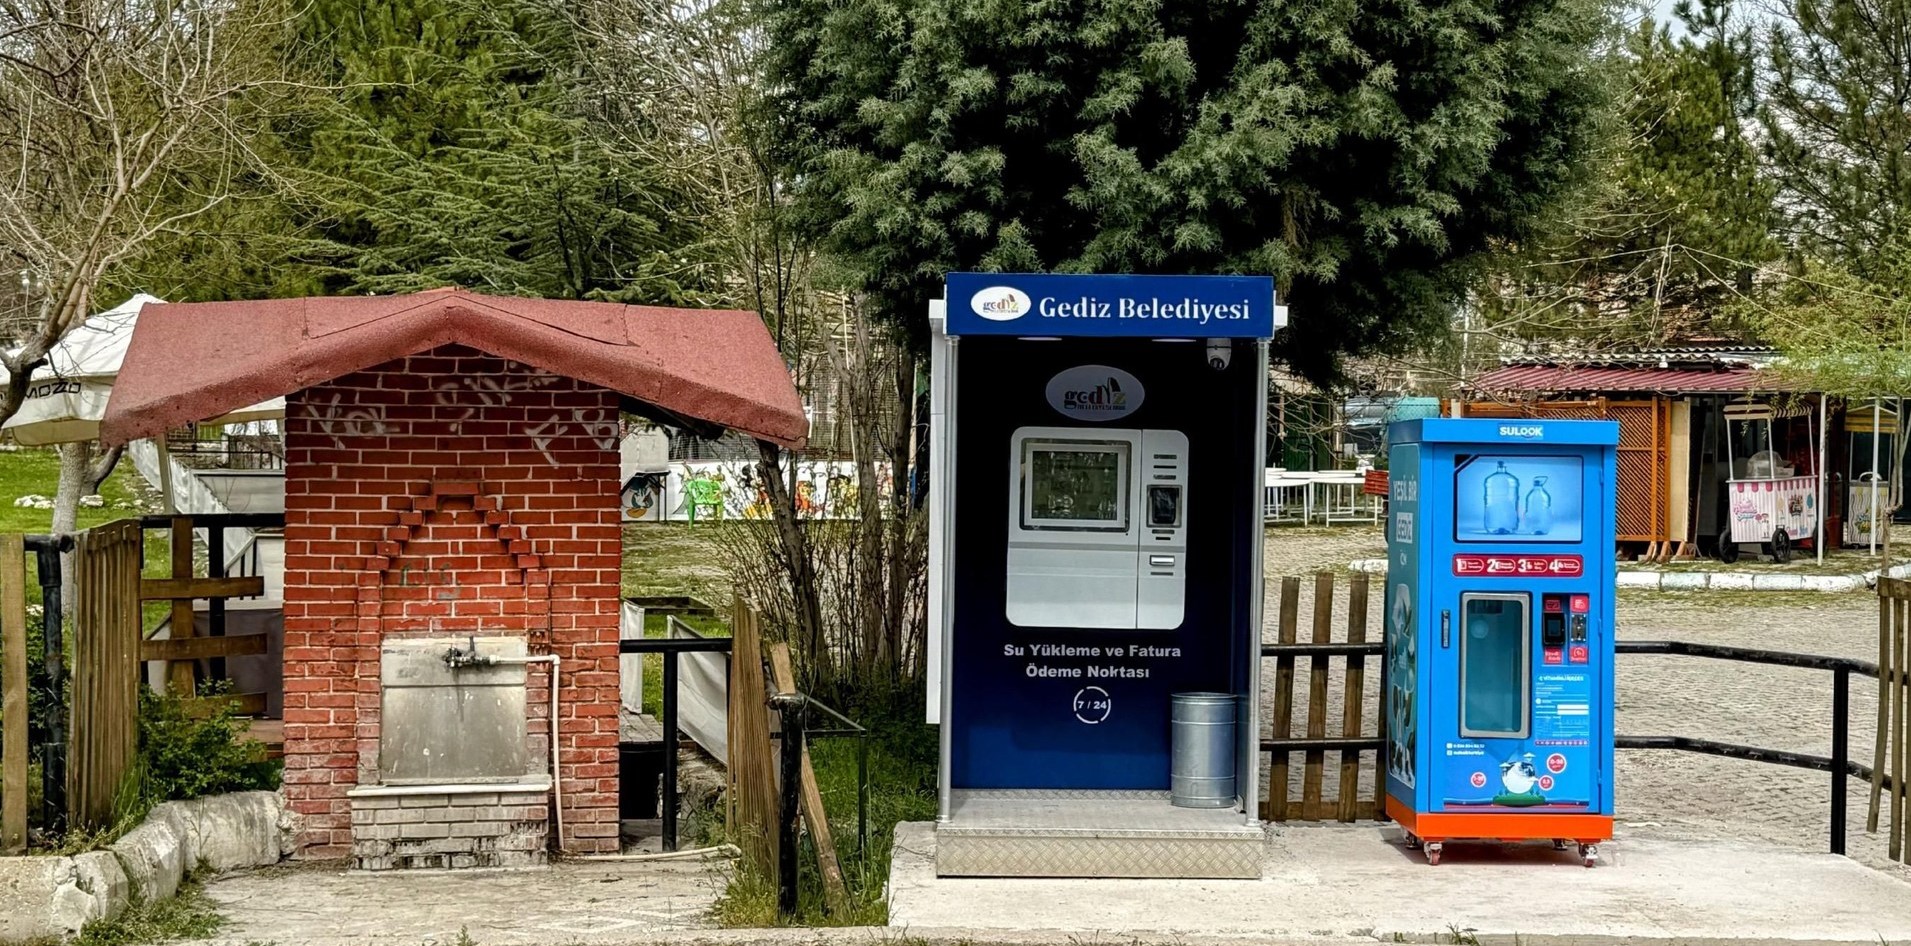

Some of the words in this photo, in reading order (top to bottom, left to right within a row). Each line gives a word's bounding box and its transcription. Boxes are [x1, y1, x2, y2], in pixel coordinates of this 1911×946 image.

[1039, 297, 1111, 318] Gediz
[1119, 298, 1250, 325] Belediyesi
[1499, 426, 1543, 437] SULOOK
[1004, 644, 1024, 657] Su
[1029, 644, 1100, 657] Yükleme
[1105, 647, 1124, 657] ve
[1129, 645, 1181, 657] Fatura
[1026, 663, 1082, 678] Ödeme
[1087, 665, 1150, 678] Noktası
